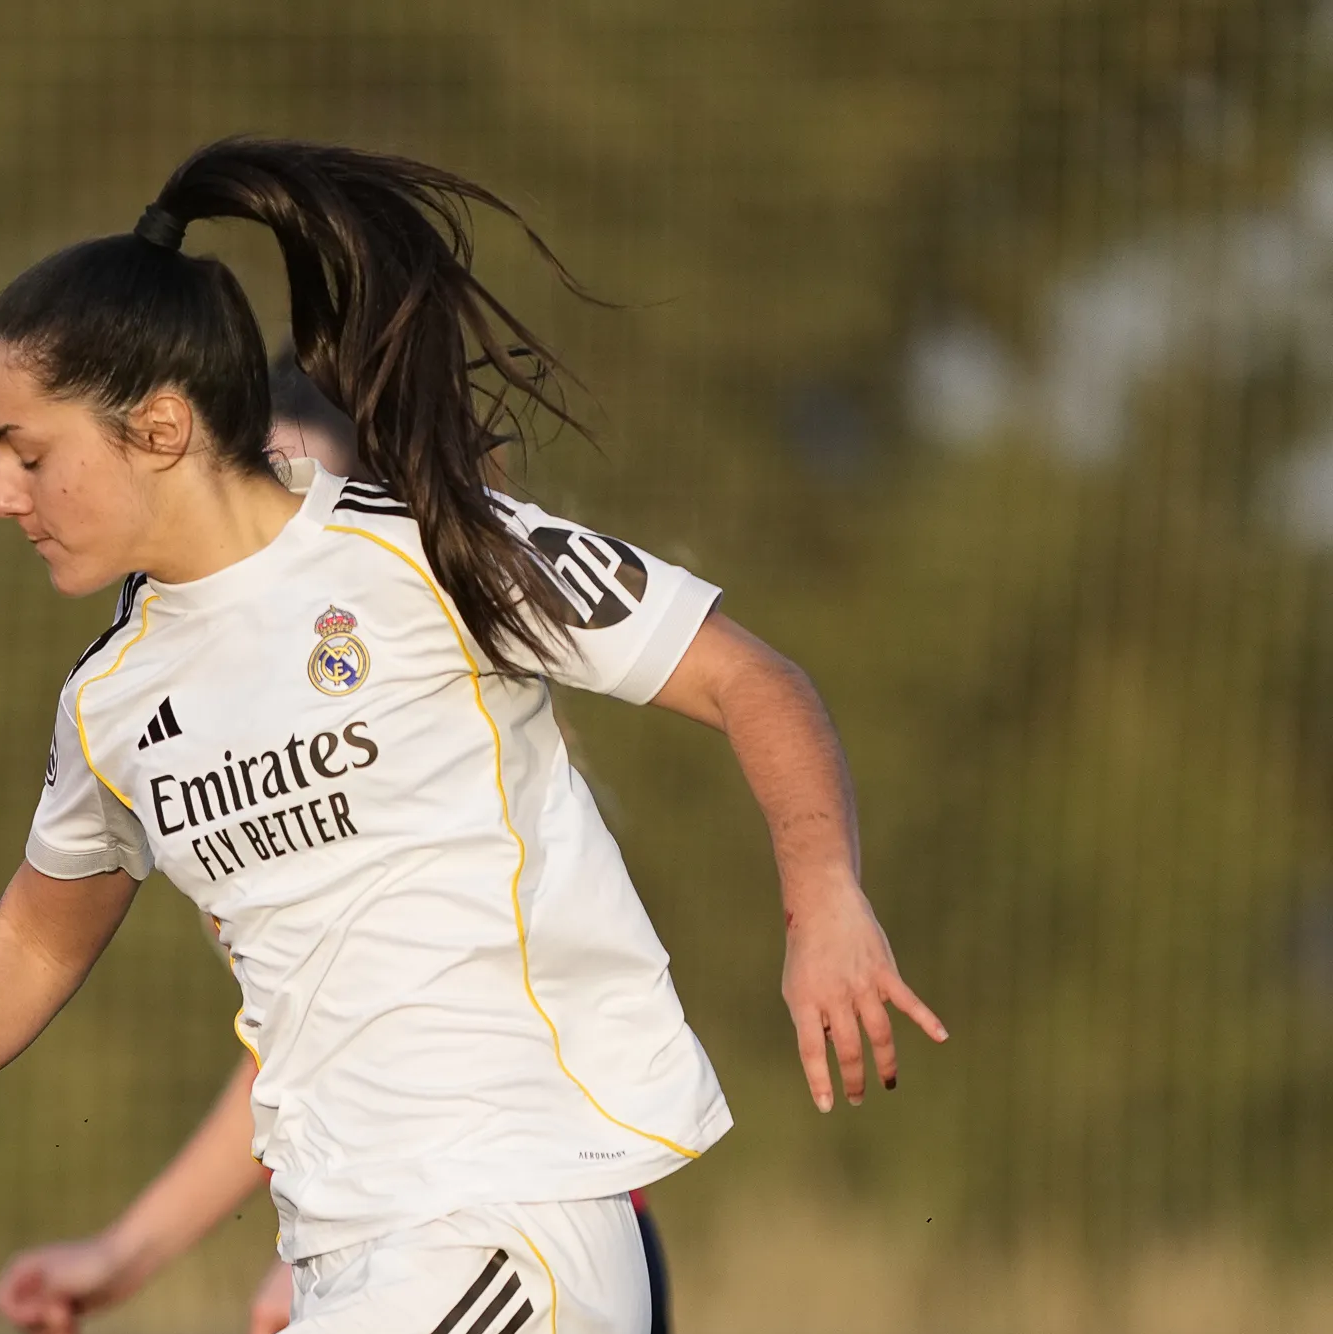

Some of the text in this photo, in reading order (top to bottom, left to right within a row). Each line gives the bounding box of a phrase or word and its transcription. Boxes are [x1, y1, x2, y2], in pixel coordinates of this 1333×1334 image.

[150, 721, 379, 836] Emirates
[192, 792, 358, 881] FLY BETTER
